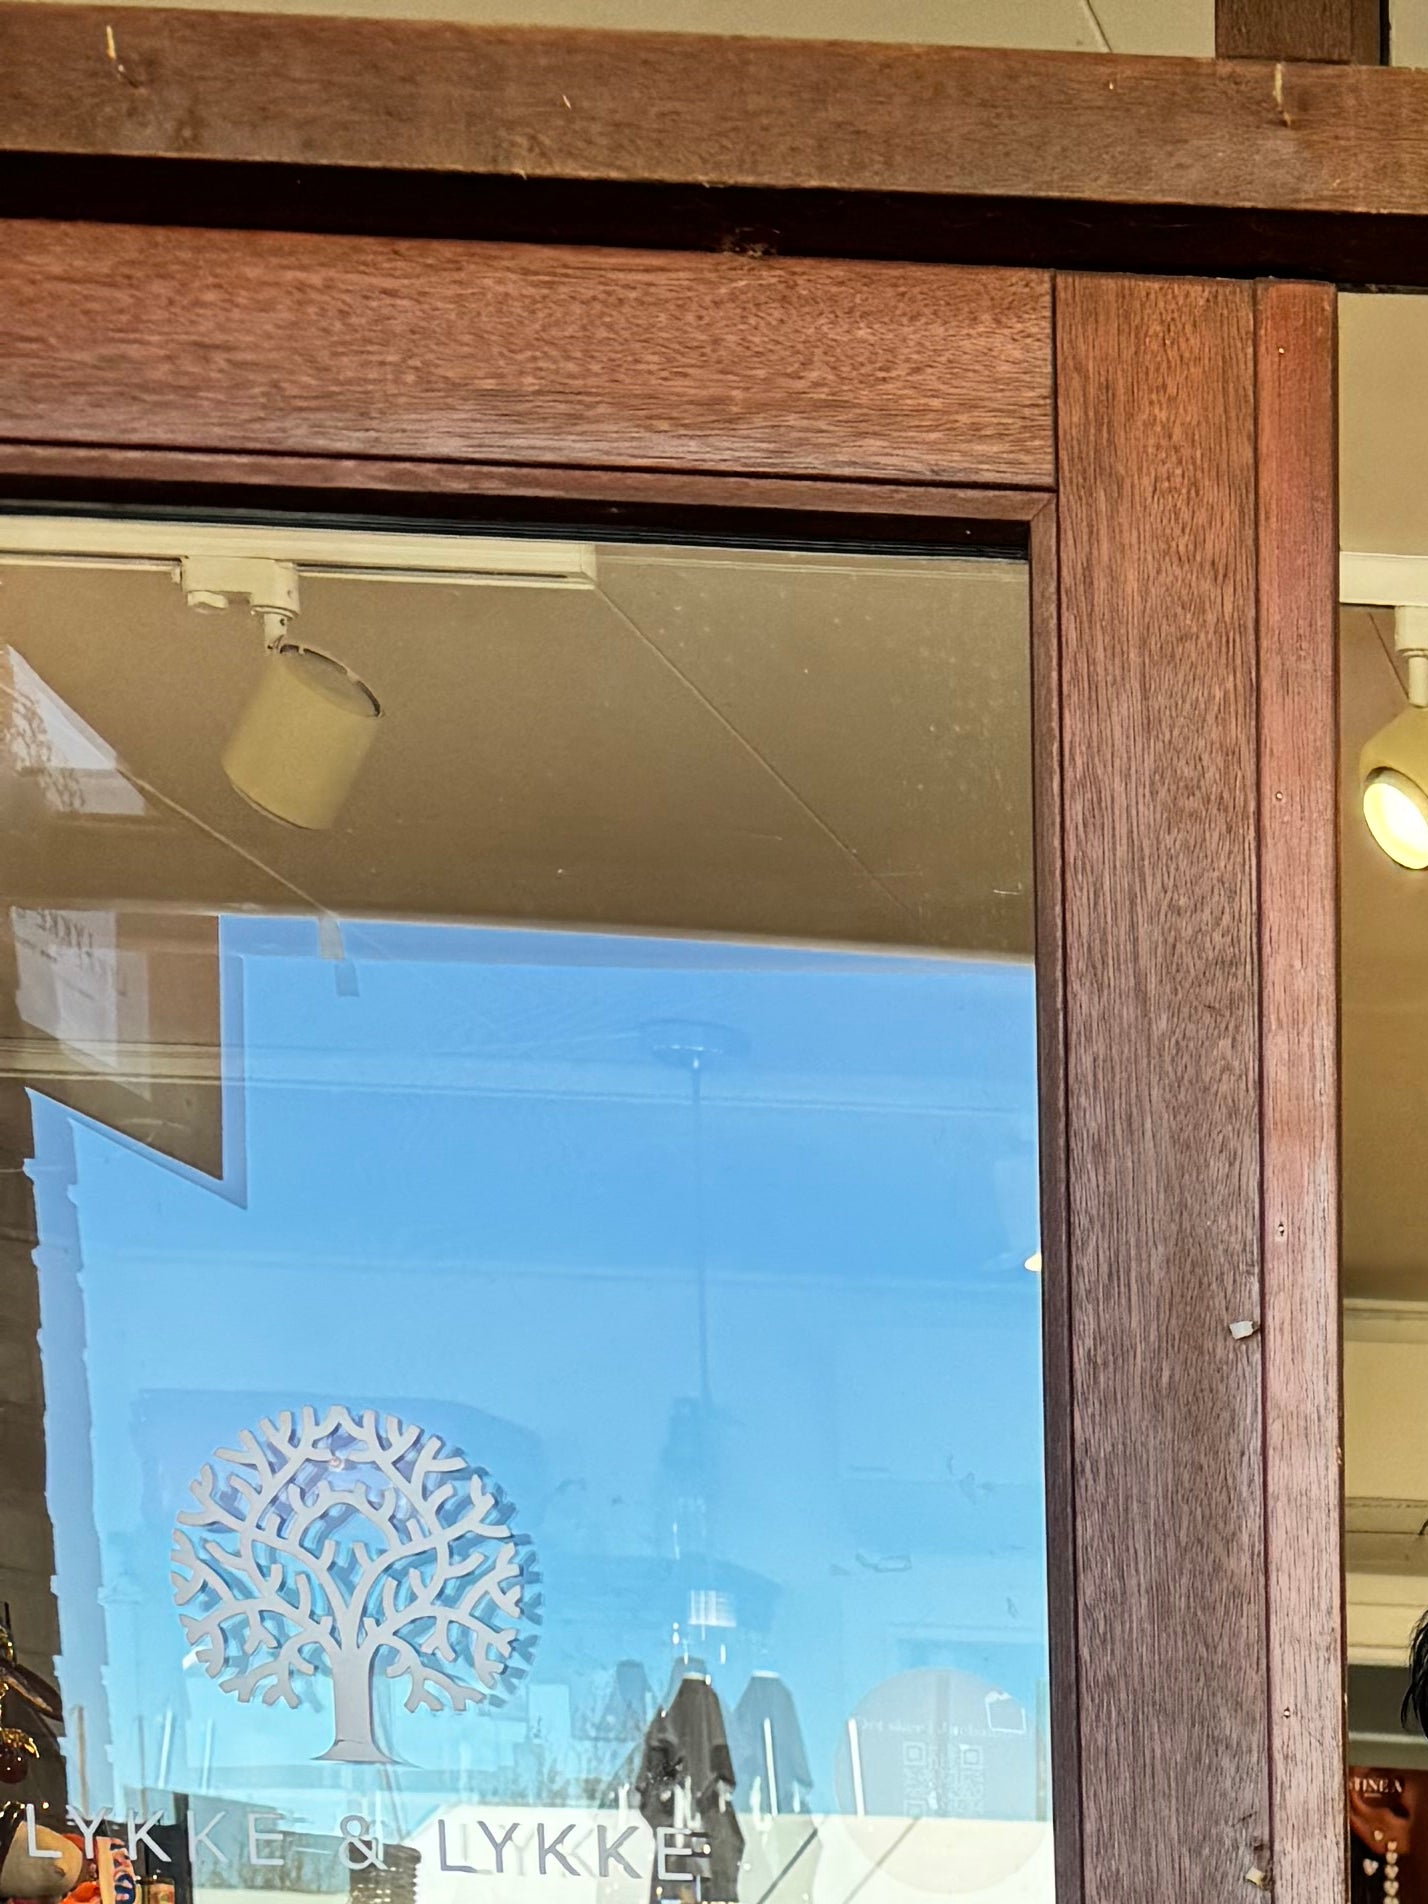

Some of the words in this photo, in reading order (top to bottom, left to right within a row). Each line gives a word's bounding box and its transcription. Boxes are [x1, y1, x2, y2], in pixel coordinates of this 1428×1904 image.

[1350, 1777, 1388, 1793] TINE
[26, 1803, 285, 1866] LYKKE
[338, 1814, 388, 1871] &
[438, 1819, 693, 1881] LYKKE
